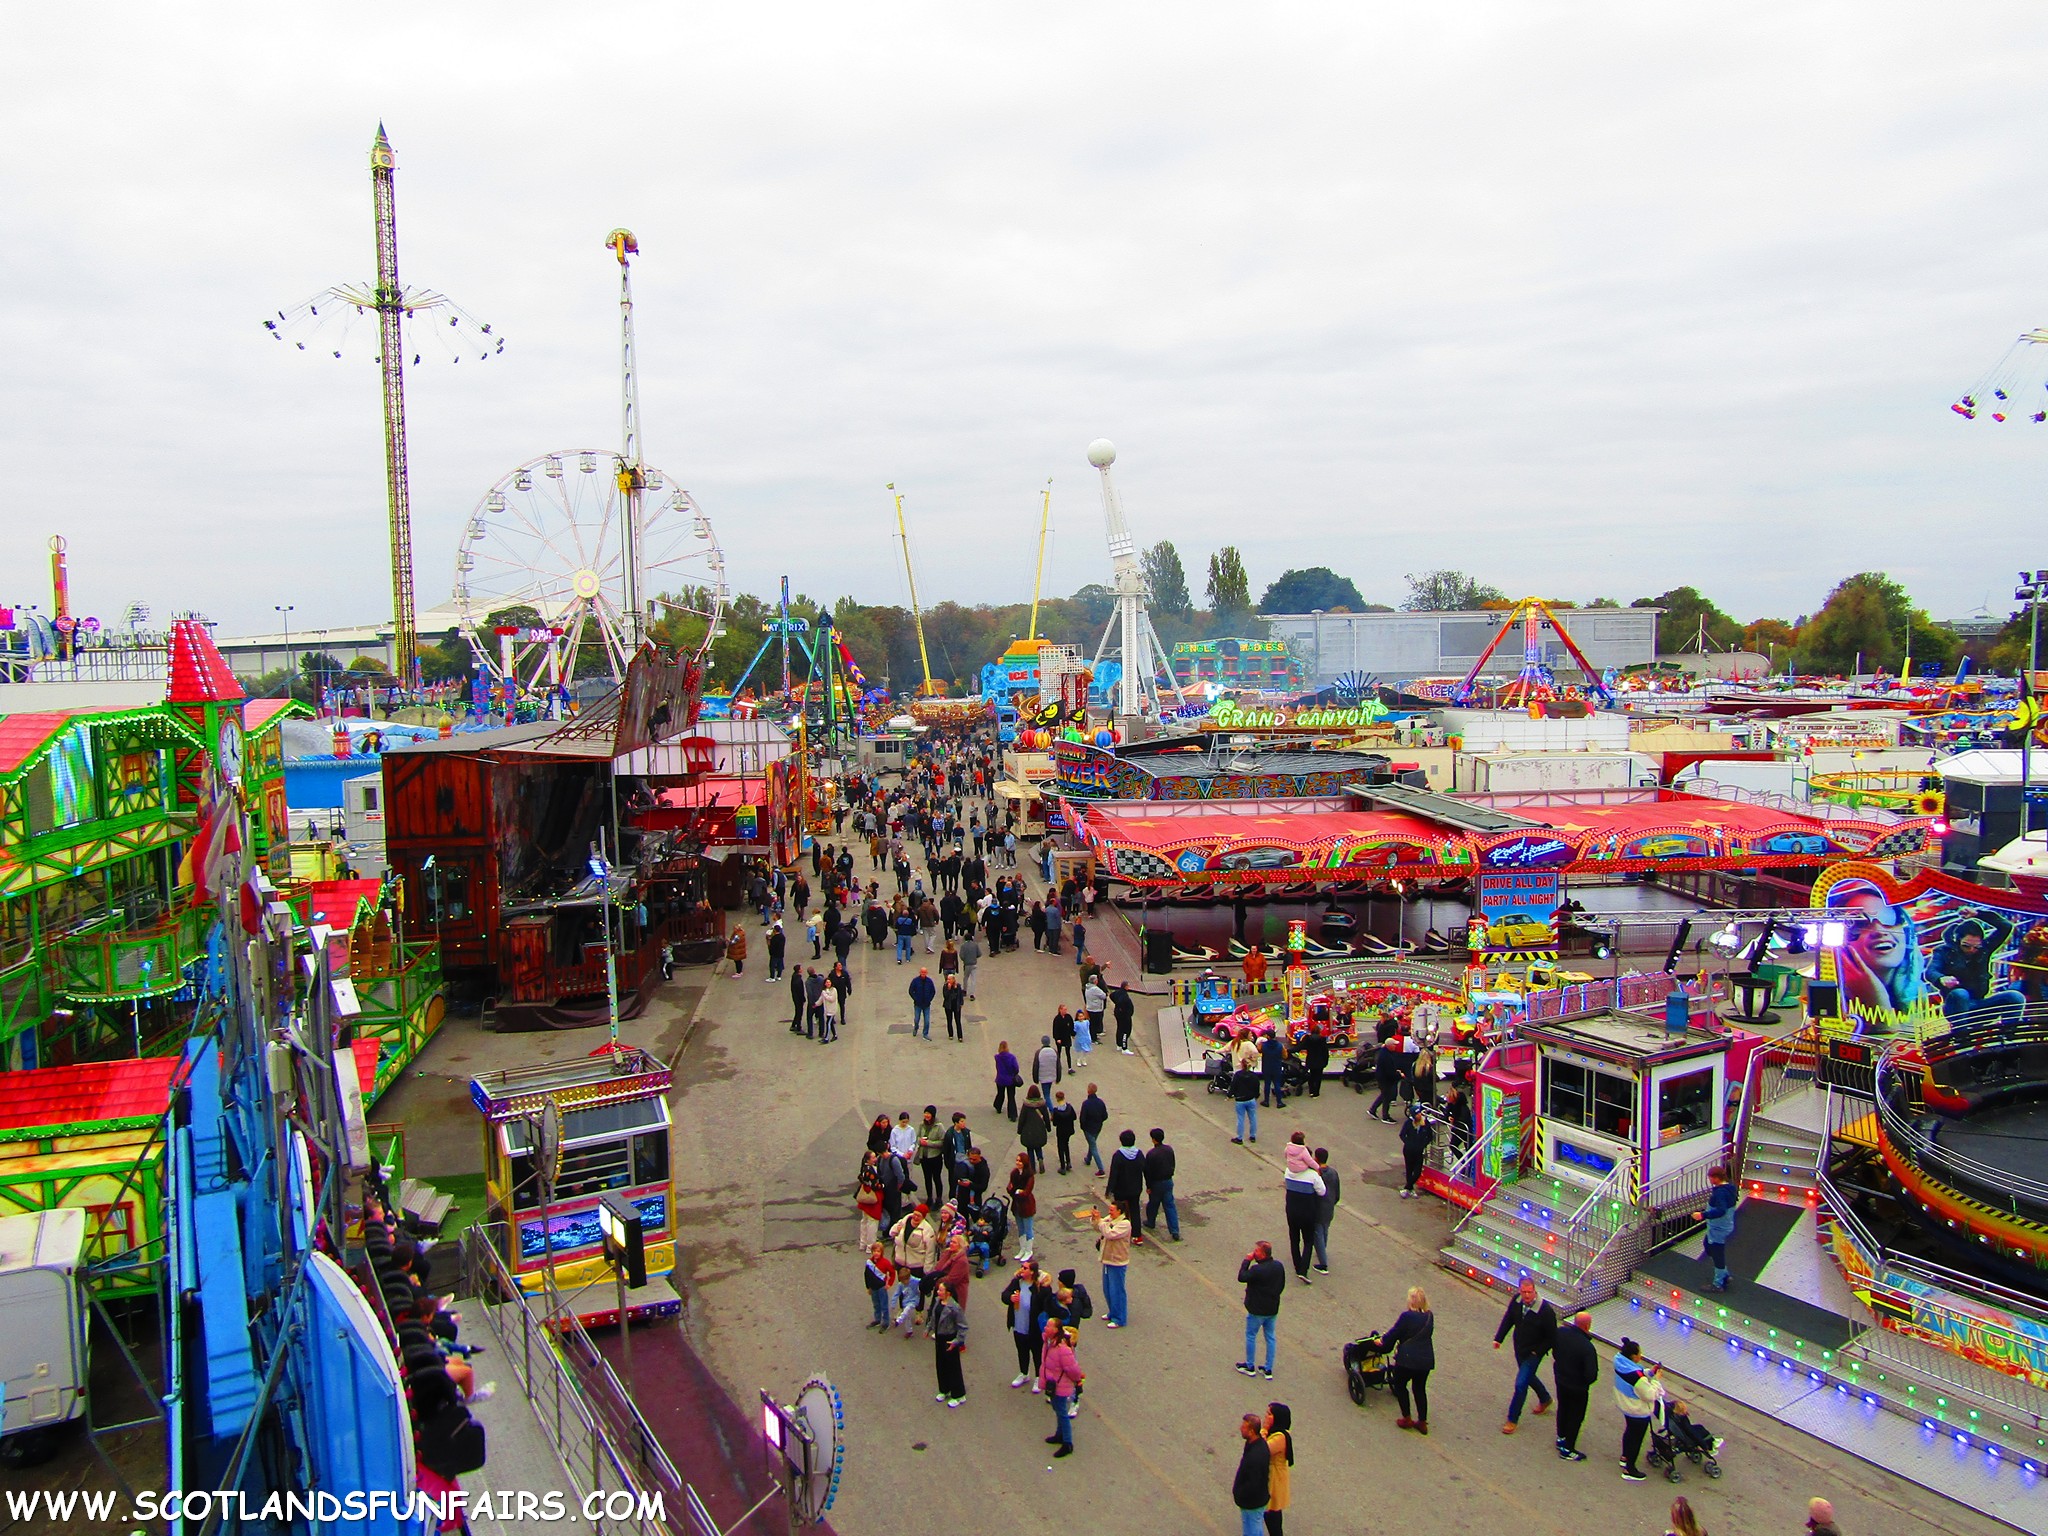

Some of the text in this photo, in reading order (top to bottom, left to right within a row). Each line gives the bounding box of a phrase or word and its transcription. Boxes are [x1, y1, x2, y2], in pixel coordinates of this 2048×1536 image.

[1178, 643, 1285, 653] JUNGLE MADNESS
[1008, 670, 1029, 681] ICE
[1218, 706, 1286, 728] GRAND
[1296, 704, 1374, 727] CANYON
[1836, 835, 1850, 844] LAS
[1488, 836, 1565, 863] Road House
[1181, 857, 1200, 872] 66
[1483, 876, 1554, 889] DRIVE ALL DAY
[1483, 893, 1555, 906] PARTY ALL NIGHT
[1839, 1043, 1862, 1062] EXIT
